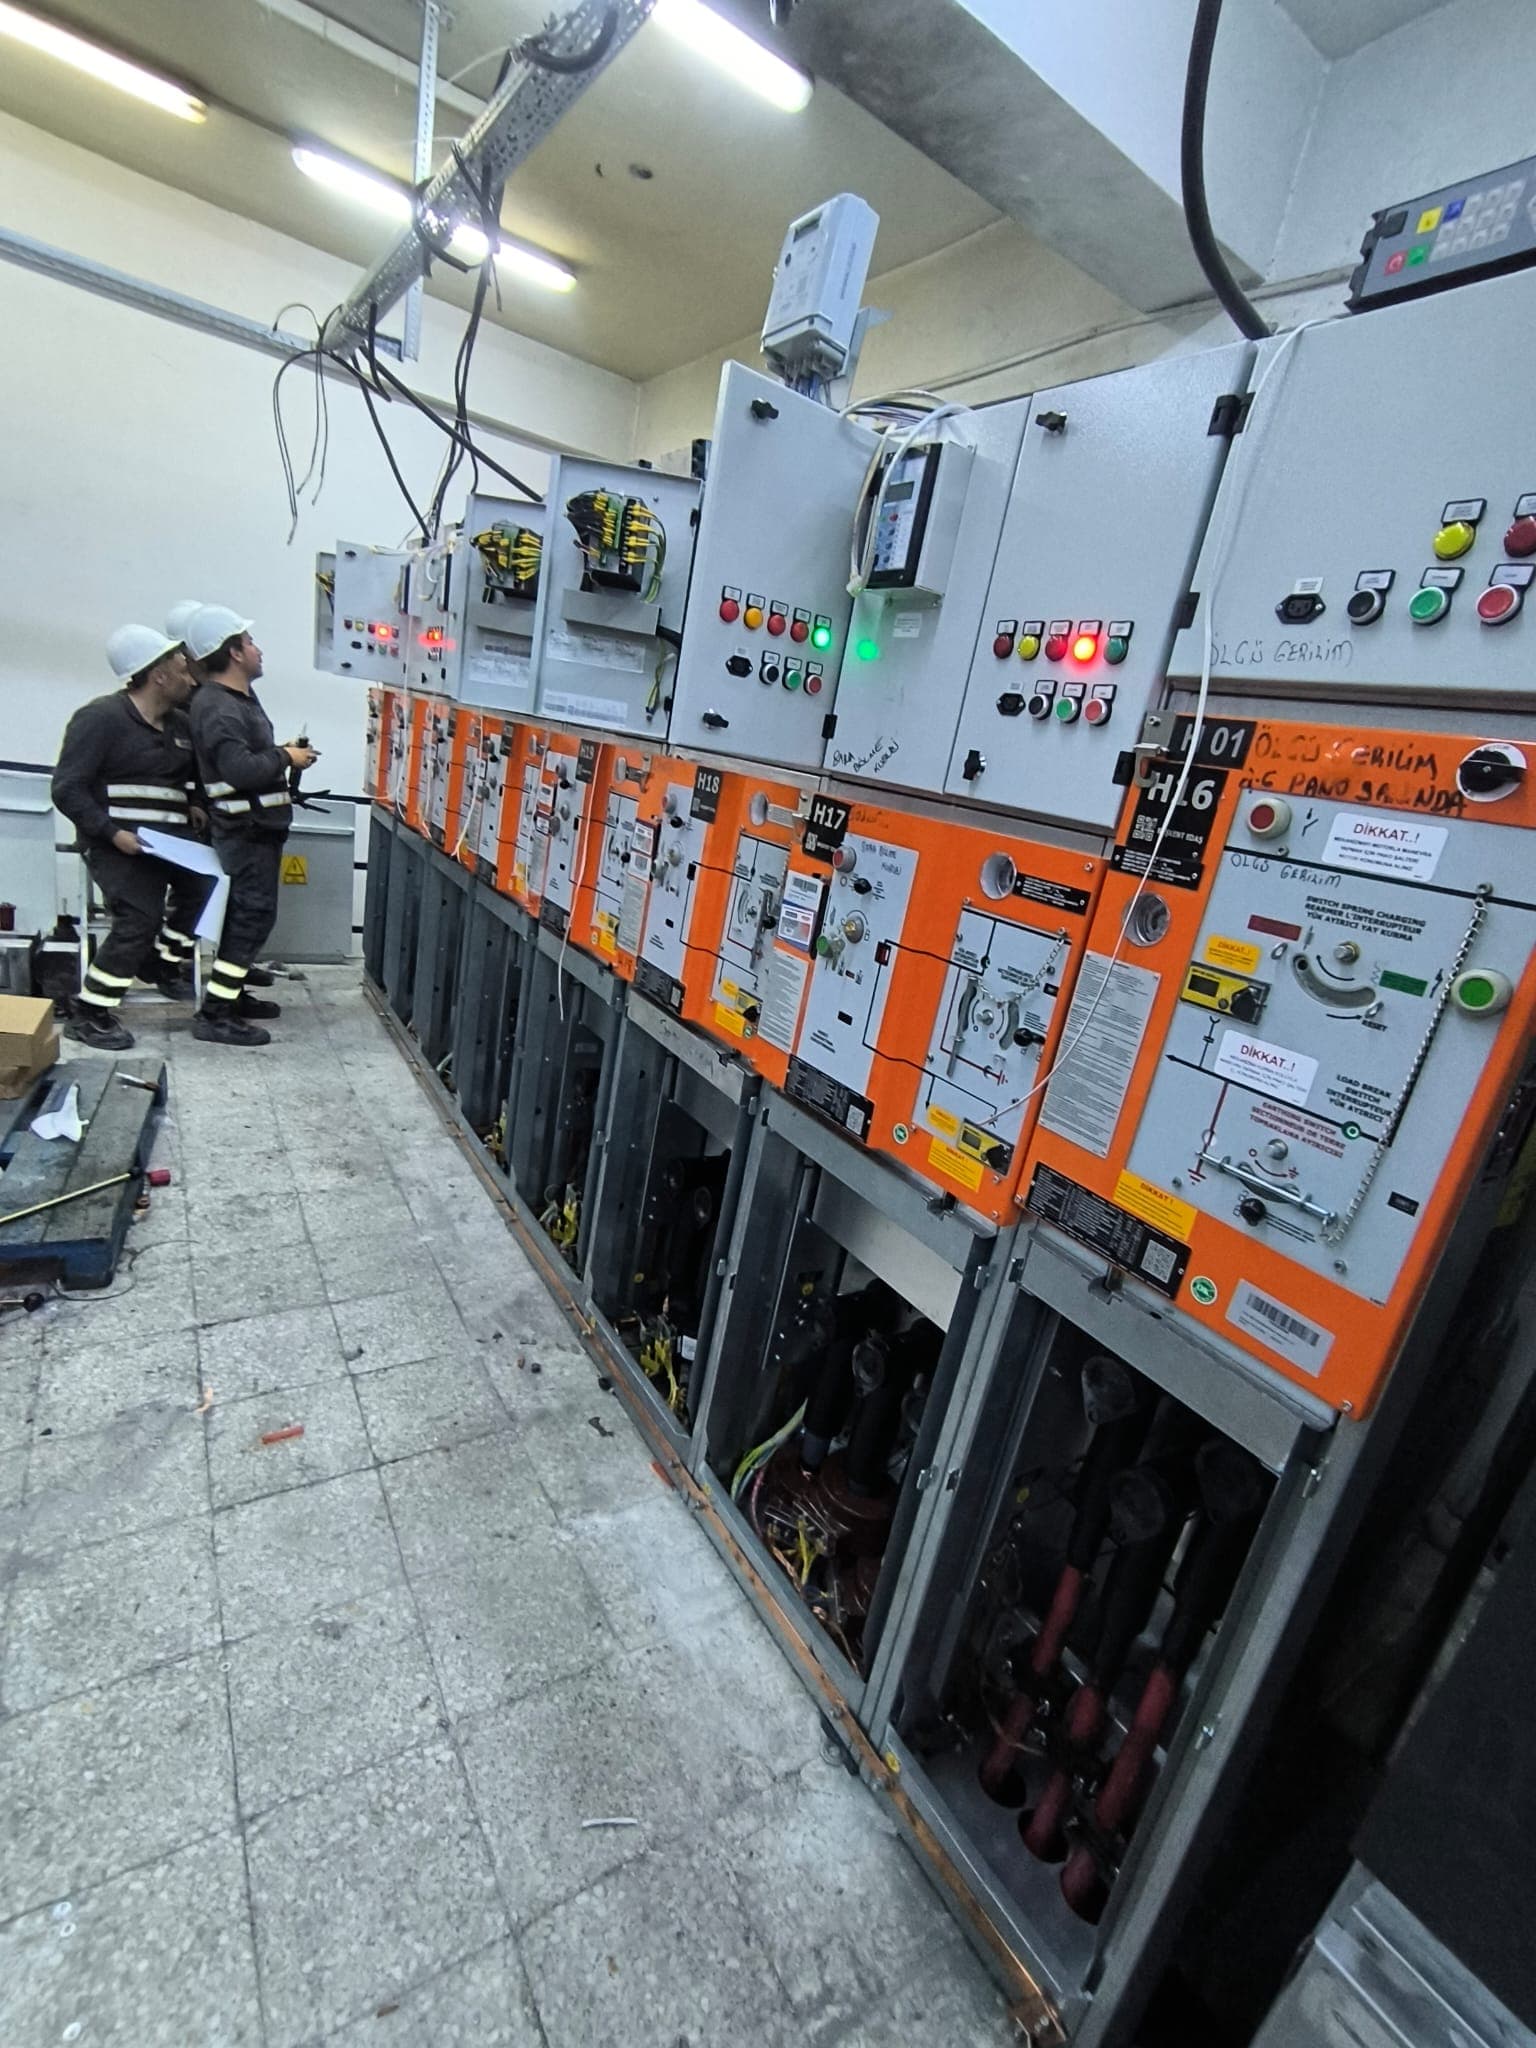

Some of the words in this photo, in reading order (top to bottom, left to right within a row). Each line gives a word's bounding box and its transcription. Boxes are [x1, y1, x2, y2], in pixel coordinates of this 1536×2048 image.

[1209, 726, 1246, 758] 01
[697, 772, 720, 794] H18
[1147, 771, 1216, 811] H16
[813, 803, 846, 830] H17
[1305, 903, 1343, 917] REARMER
[1306, 895, 1340, 908] SWITCH
[1341, 903, 1375, 916] SPRING
[1376, 911, 1426, 928] CHARGING
[1361, 924, 1378, 933] YAY
[1380, 929, 1413, 941] KURMA
[1337, 1074, 1360, 1087] LOAD
[1362, 1083, 1392, 1098] BREAK
